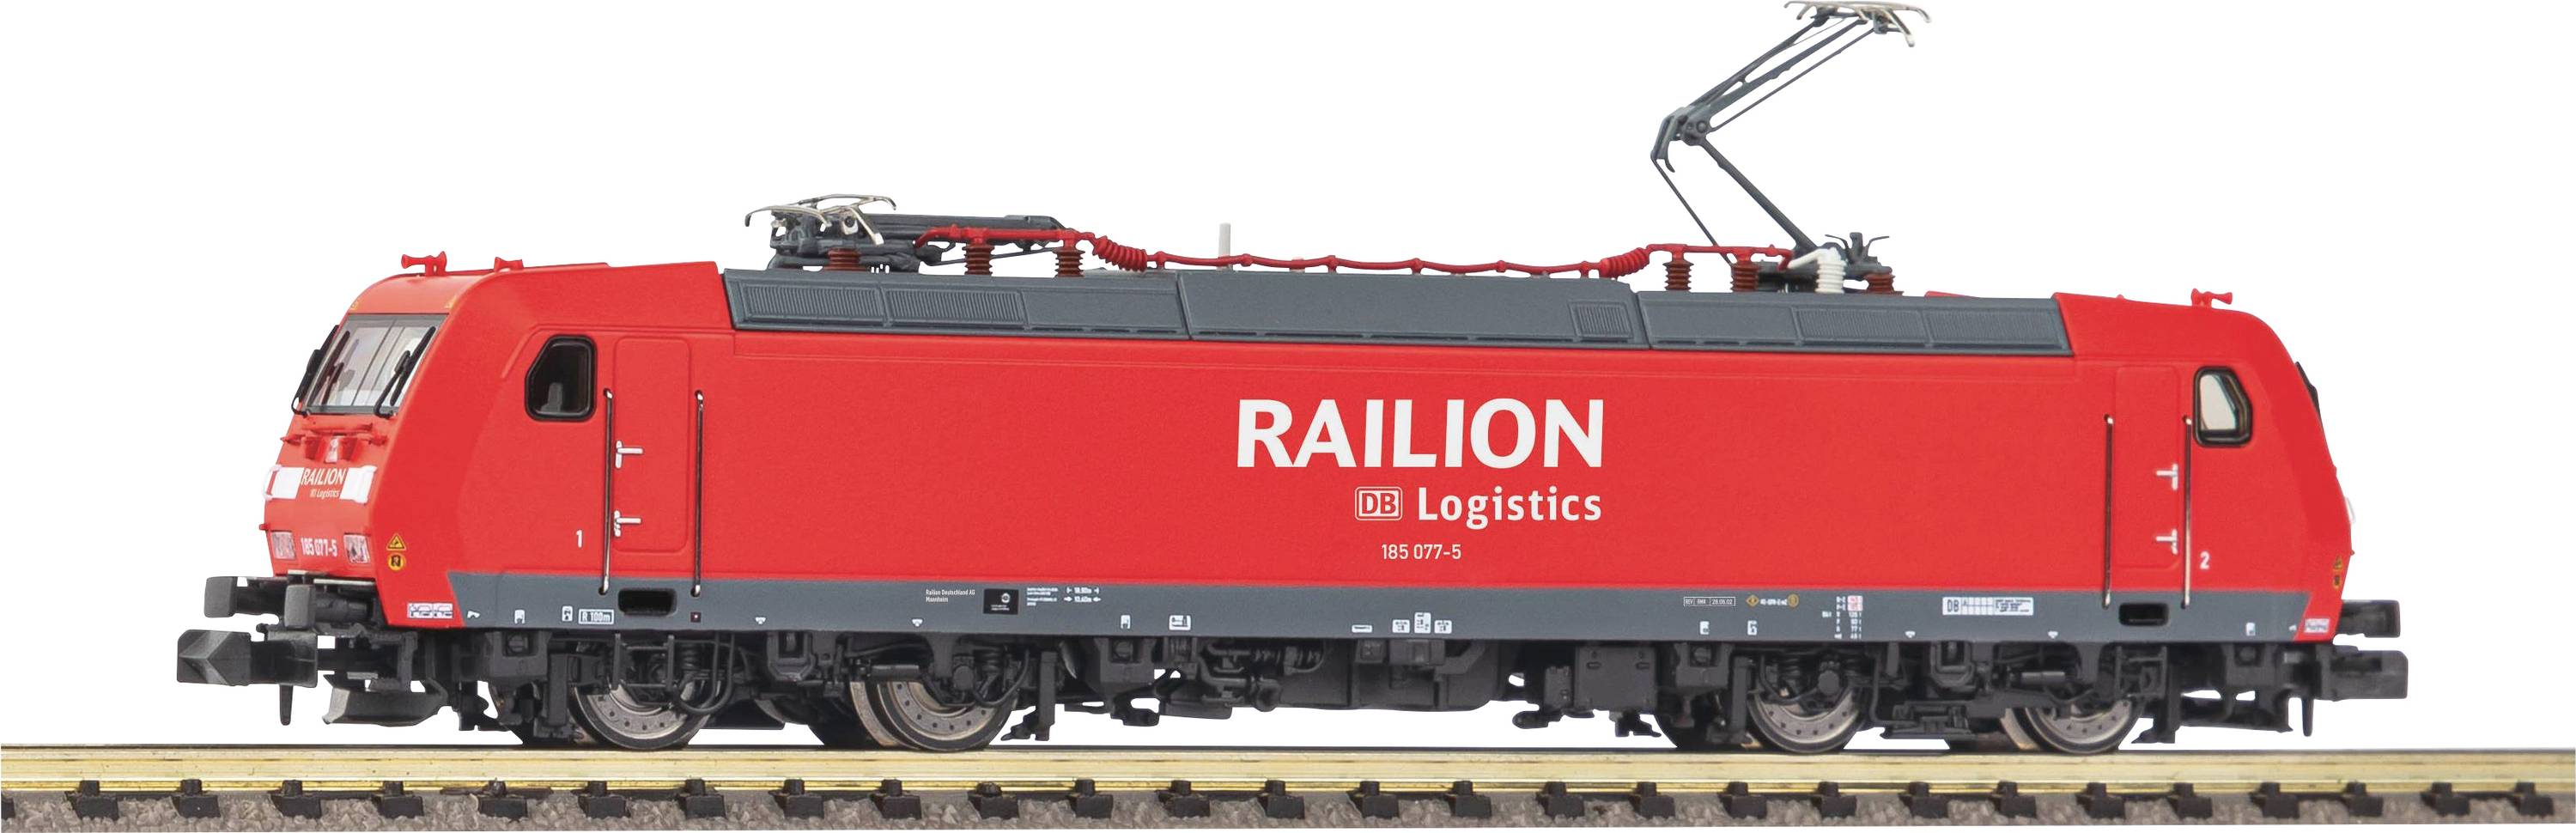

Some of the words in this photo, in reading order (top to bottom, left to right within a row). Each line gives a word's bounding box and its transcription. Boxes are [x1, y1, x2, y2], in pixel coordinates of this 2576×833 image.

[1236, 398, 1604, 470] RAILION
[301, 467, 346, 486] RAILION
[317, 489, 340, 500] Logistics
[1358, 490, 1400, 516] DB
[1418, 485, 1602, 530] Logistics
[576, 529, 583, 548] 1
[1382, 544, 1409, 560] 185
[1413, 544, 1461, 560] 077-5
[2199, 551, 2210, 569] 2
[1947, 599, 1959, 612] DB
[582, 611, 587, 622] R
